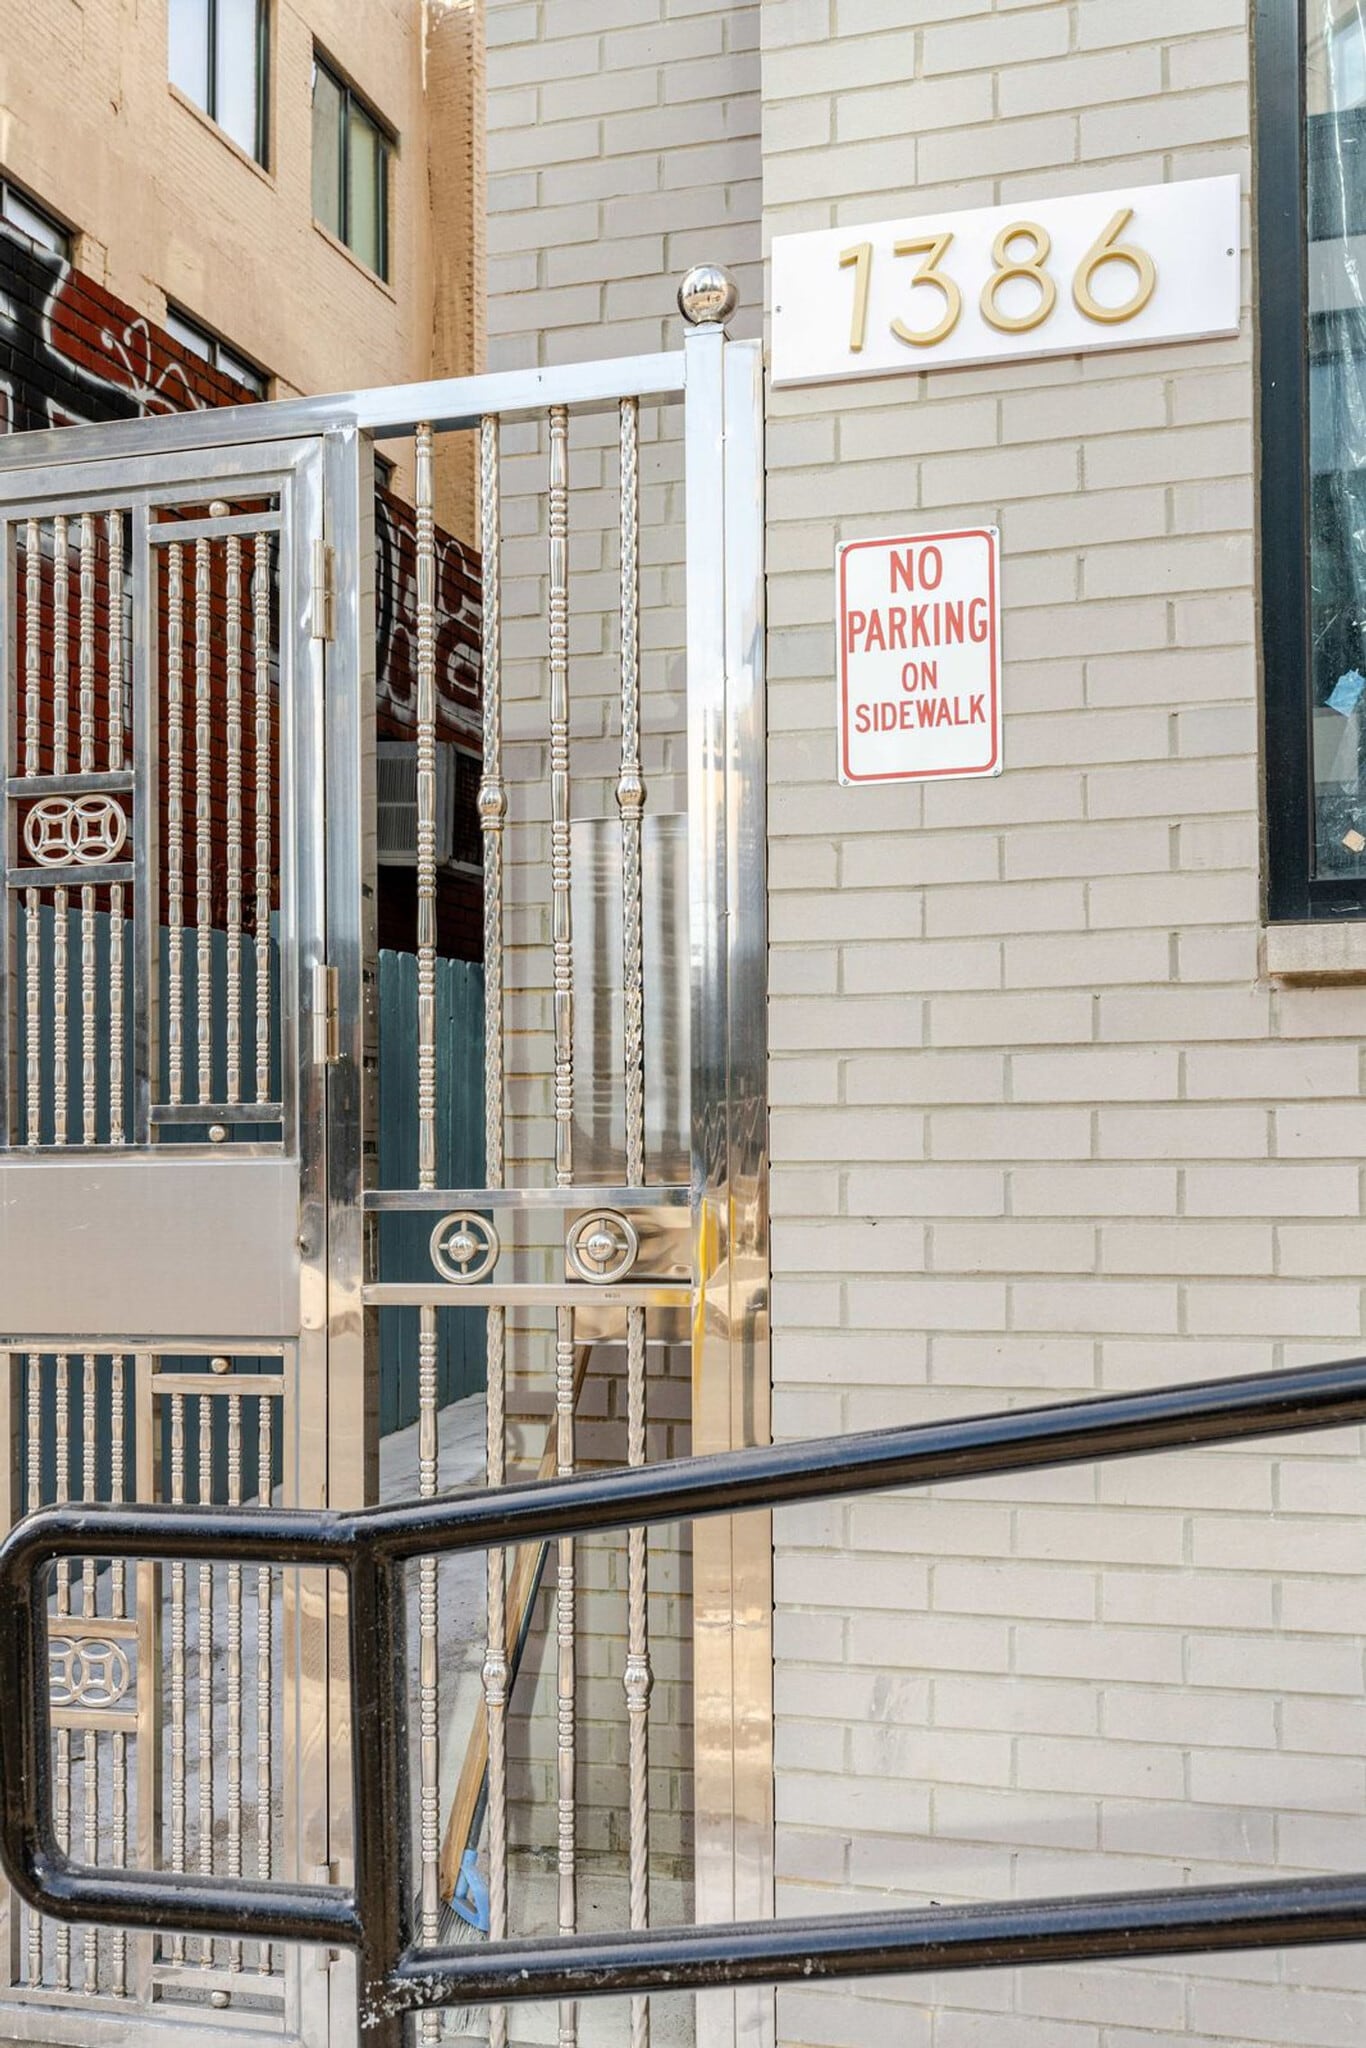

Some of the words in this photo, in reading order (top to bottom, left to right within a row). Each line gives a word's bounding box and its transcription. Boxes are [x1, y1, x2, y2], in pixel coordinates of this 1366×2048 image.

[838, 208, 1156, 352] 1386
[889, 545, 943, 594] NO
[847, 597, 988, 653] PARKING
[901, 661, 937, 692] ON
[855, 694, 986, 733] SIDEWALK
